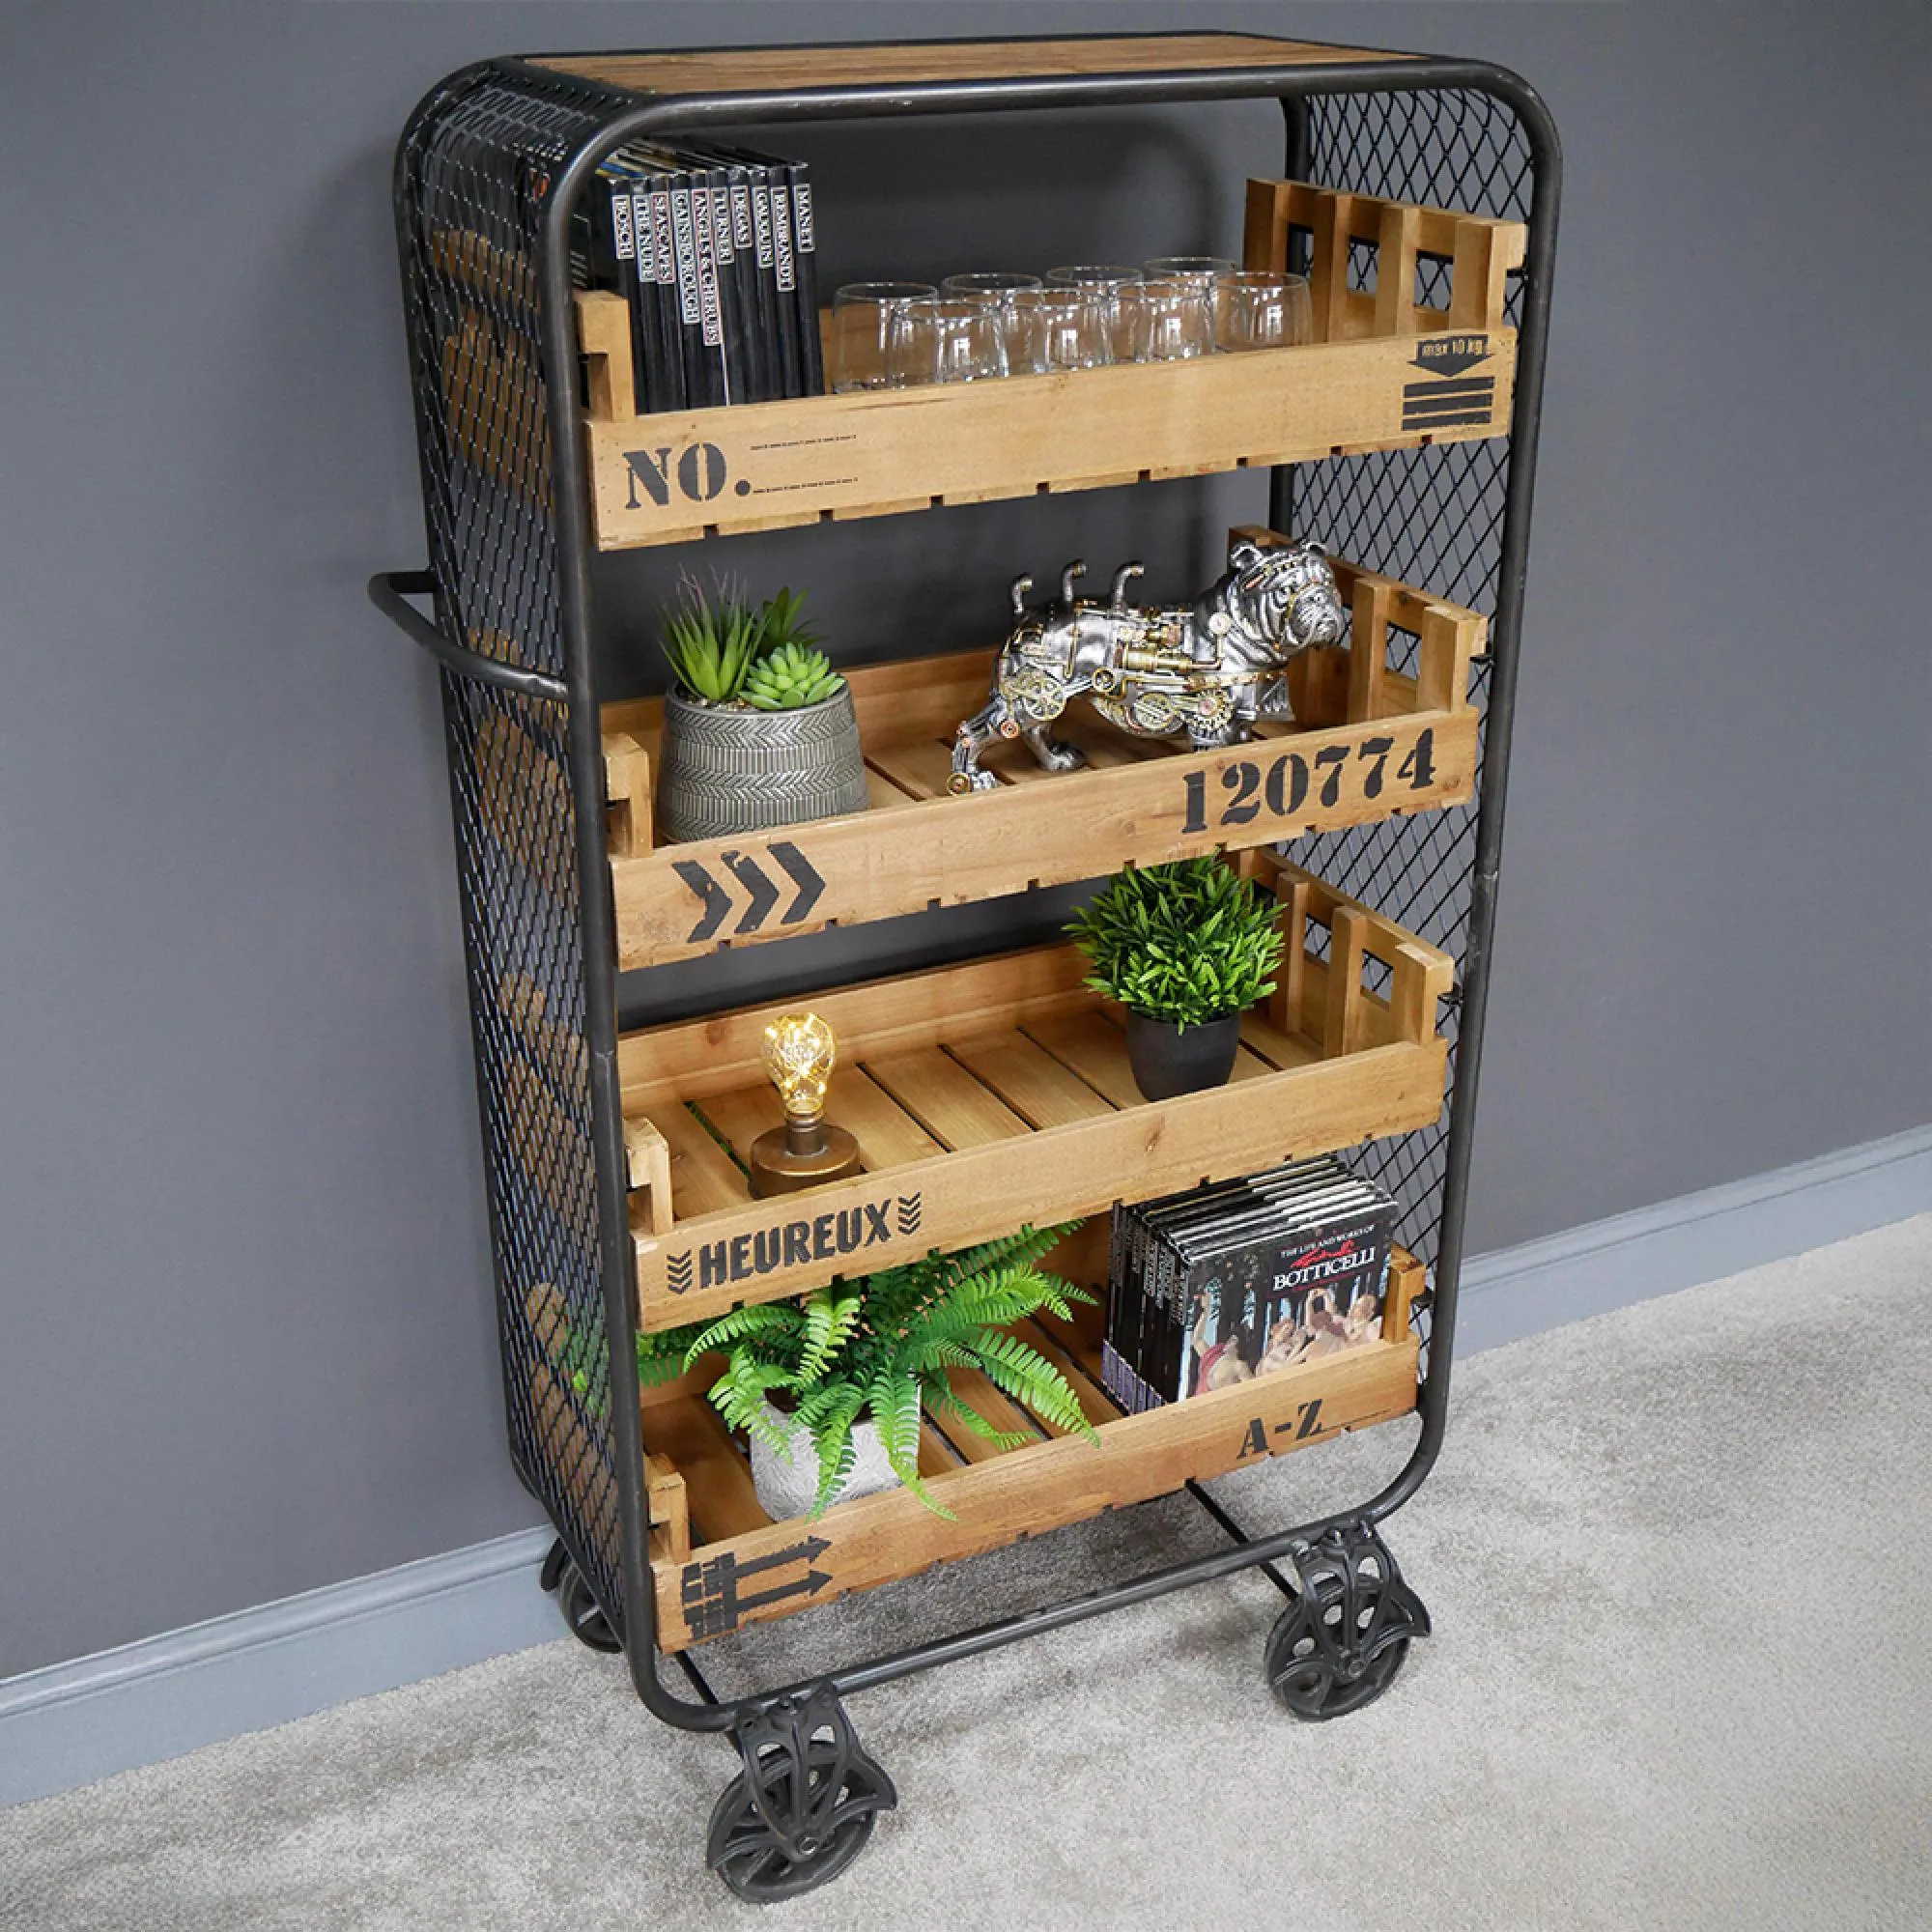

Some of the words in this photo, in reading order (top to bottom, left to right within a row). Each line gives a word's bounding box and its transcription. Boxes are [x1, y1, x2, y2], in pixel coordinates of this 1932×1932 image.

[636, 201, 649, 229] THE
[714, 196, 732, 259] TURNER
[733, 192, 749, 242] DEGAS
[755, 191, 773, 262] GAUGUIN
[774, 193, 792, 284] REMBRANDT
[796, 190, 812, 246] MANET
[639, 235, 654, 278] NUDE
[1452, 339, 1465, 355] 10
[621, 441, 752, 510] NO.
[1181, 727, 1436, 834] 120774
[698, 1198, 892, 1290] HEUREUX
[1272, 1246, 1376, 1292] BOTTICELLI
[1236, 1399, 1323, 1460] A-Z
